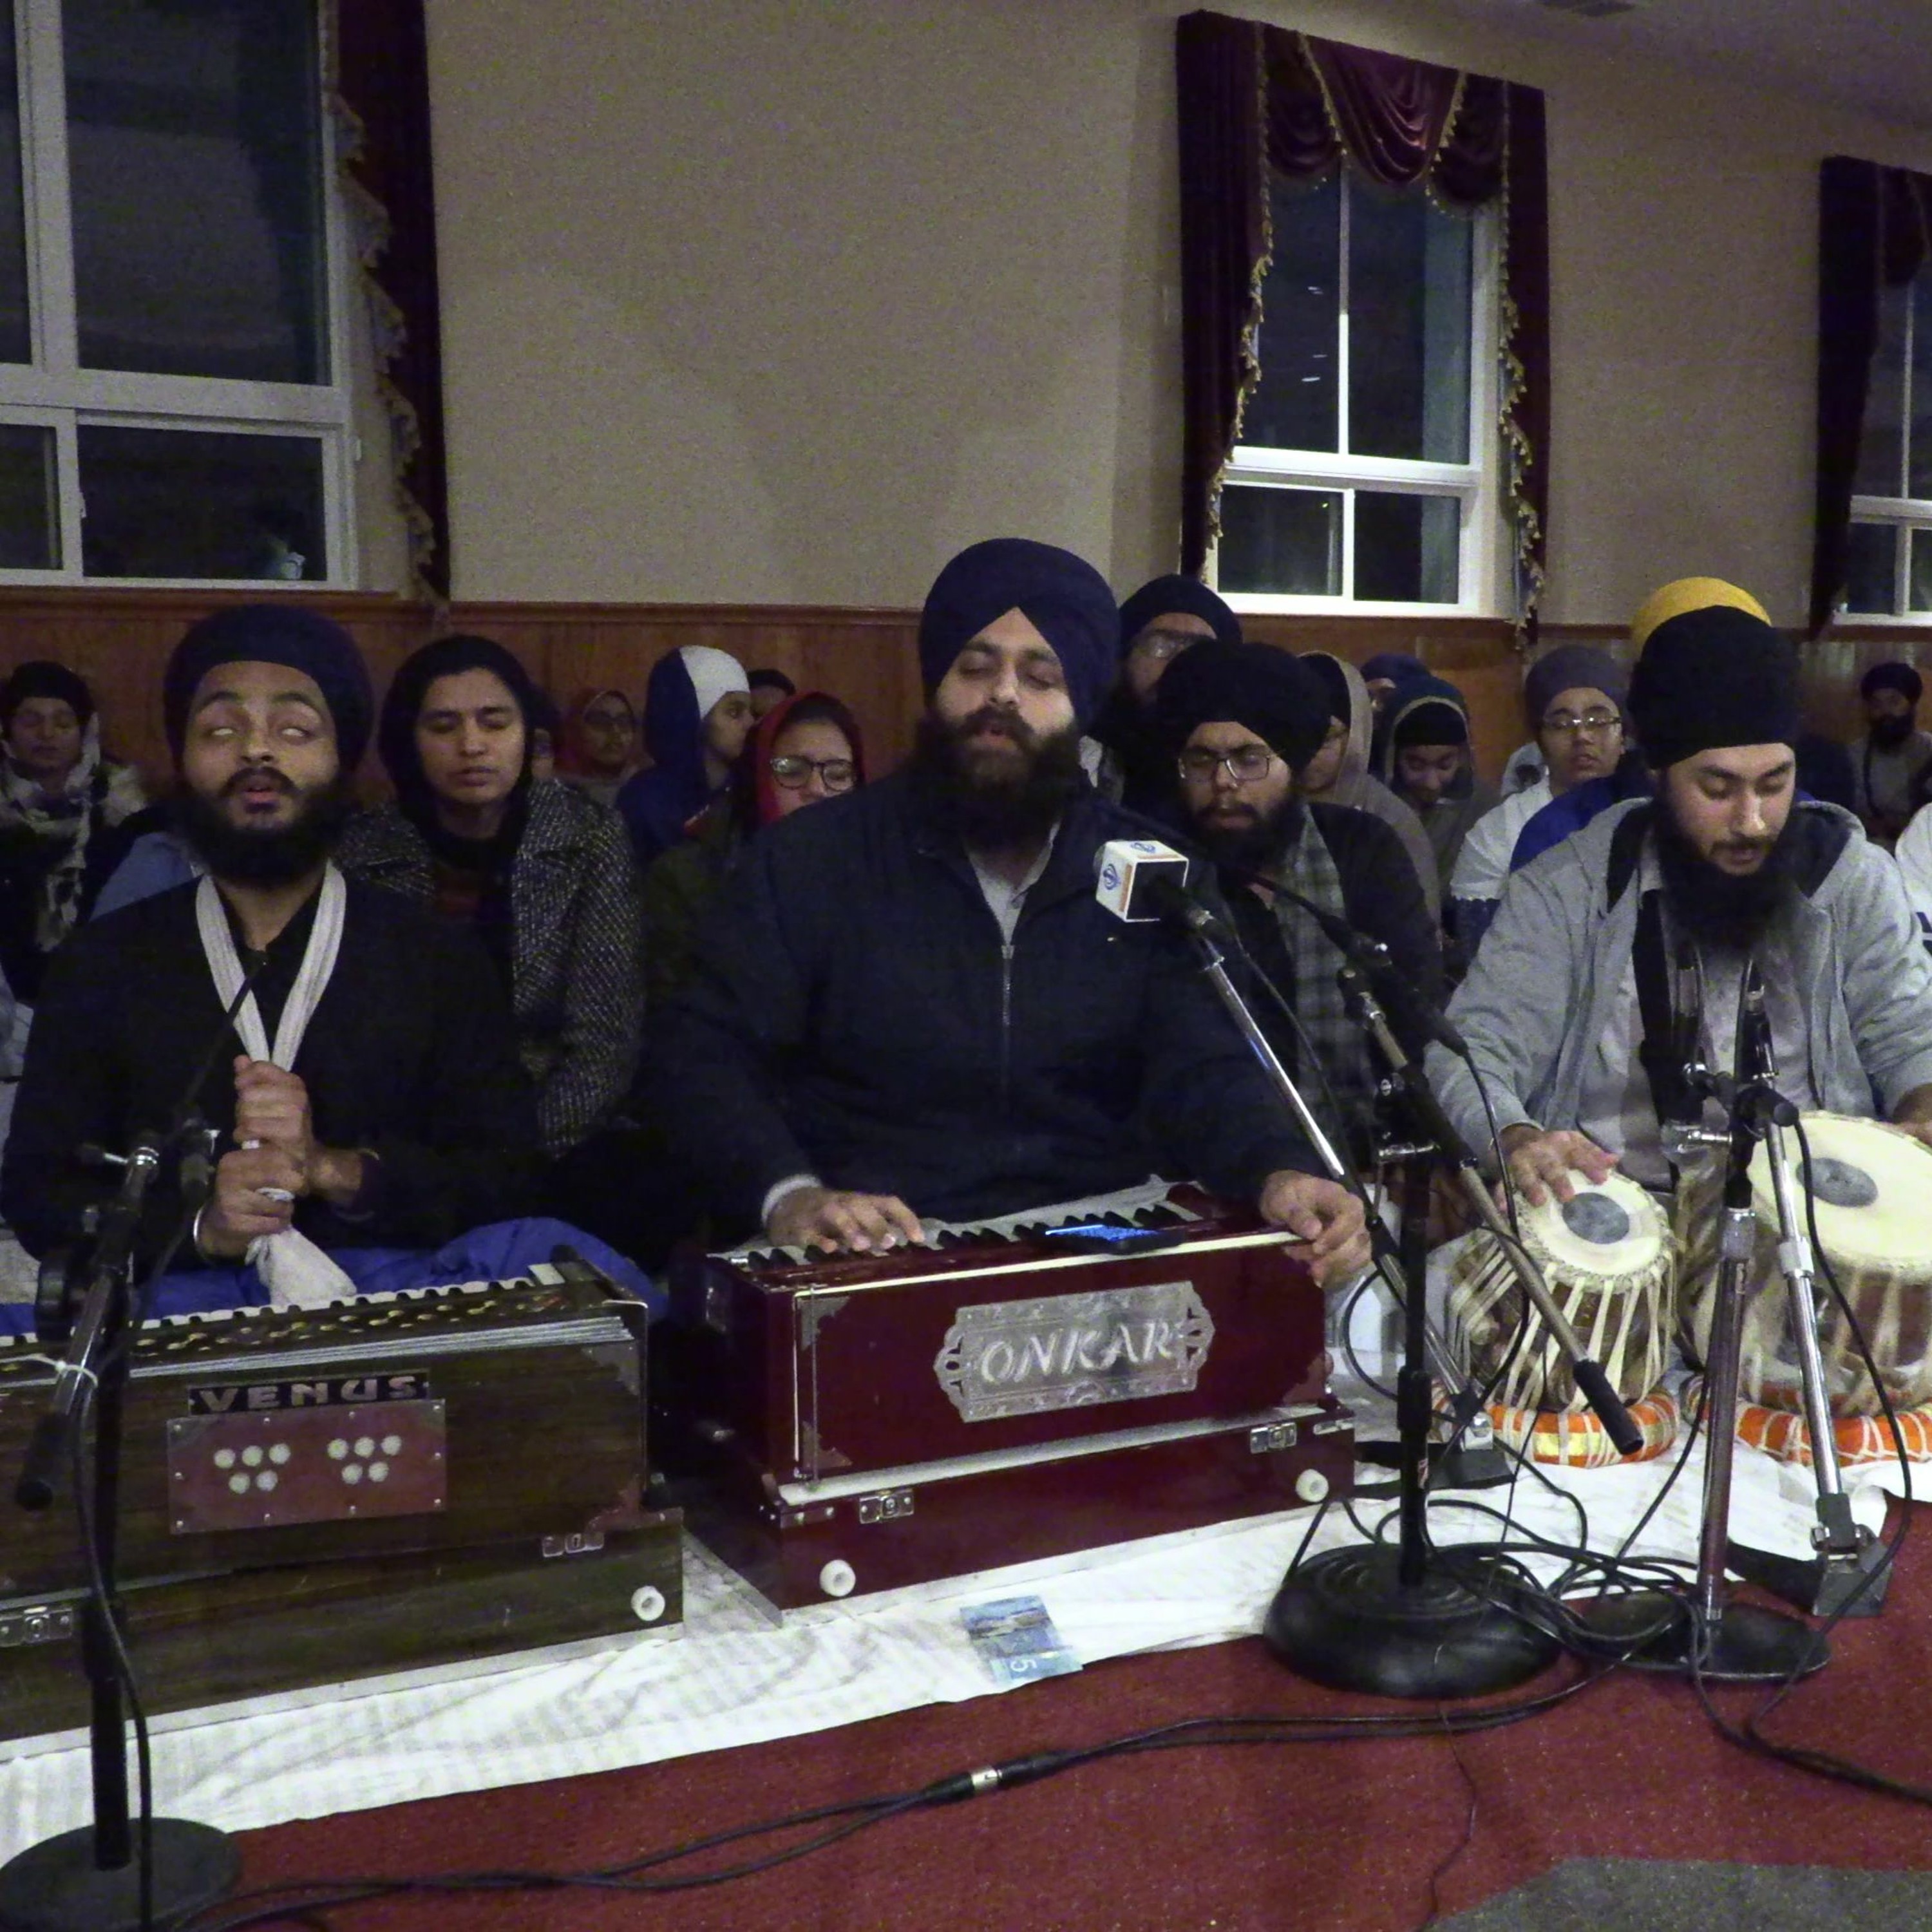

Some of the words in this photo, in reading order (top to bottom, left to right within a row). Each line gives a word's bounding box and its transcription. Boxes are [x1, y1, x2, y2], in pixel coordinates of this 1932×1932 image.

[981, 1320, 1172, 1382] ONKAR
[200, 1376, 415, 1412] VENUS
[1010, 1659, 1037, 1672] 5
